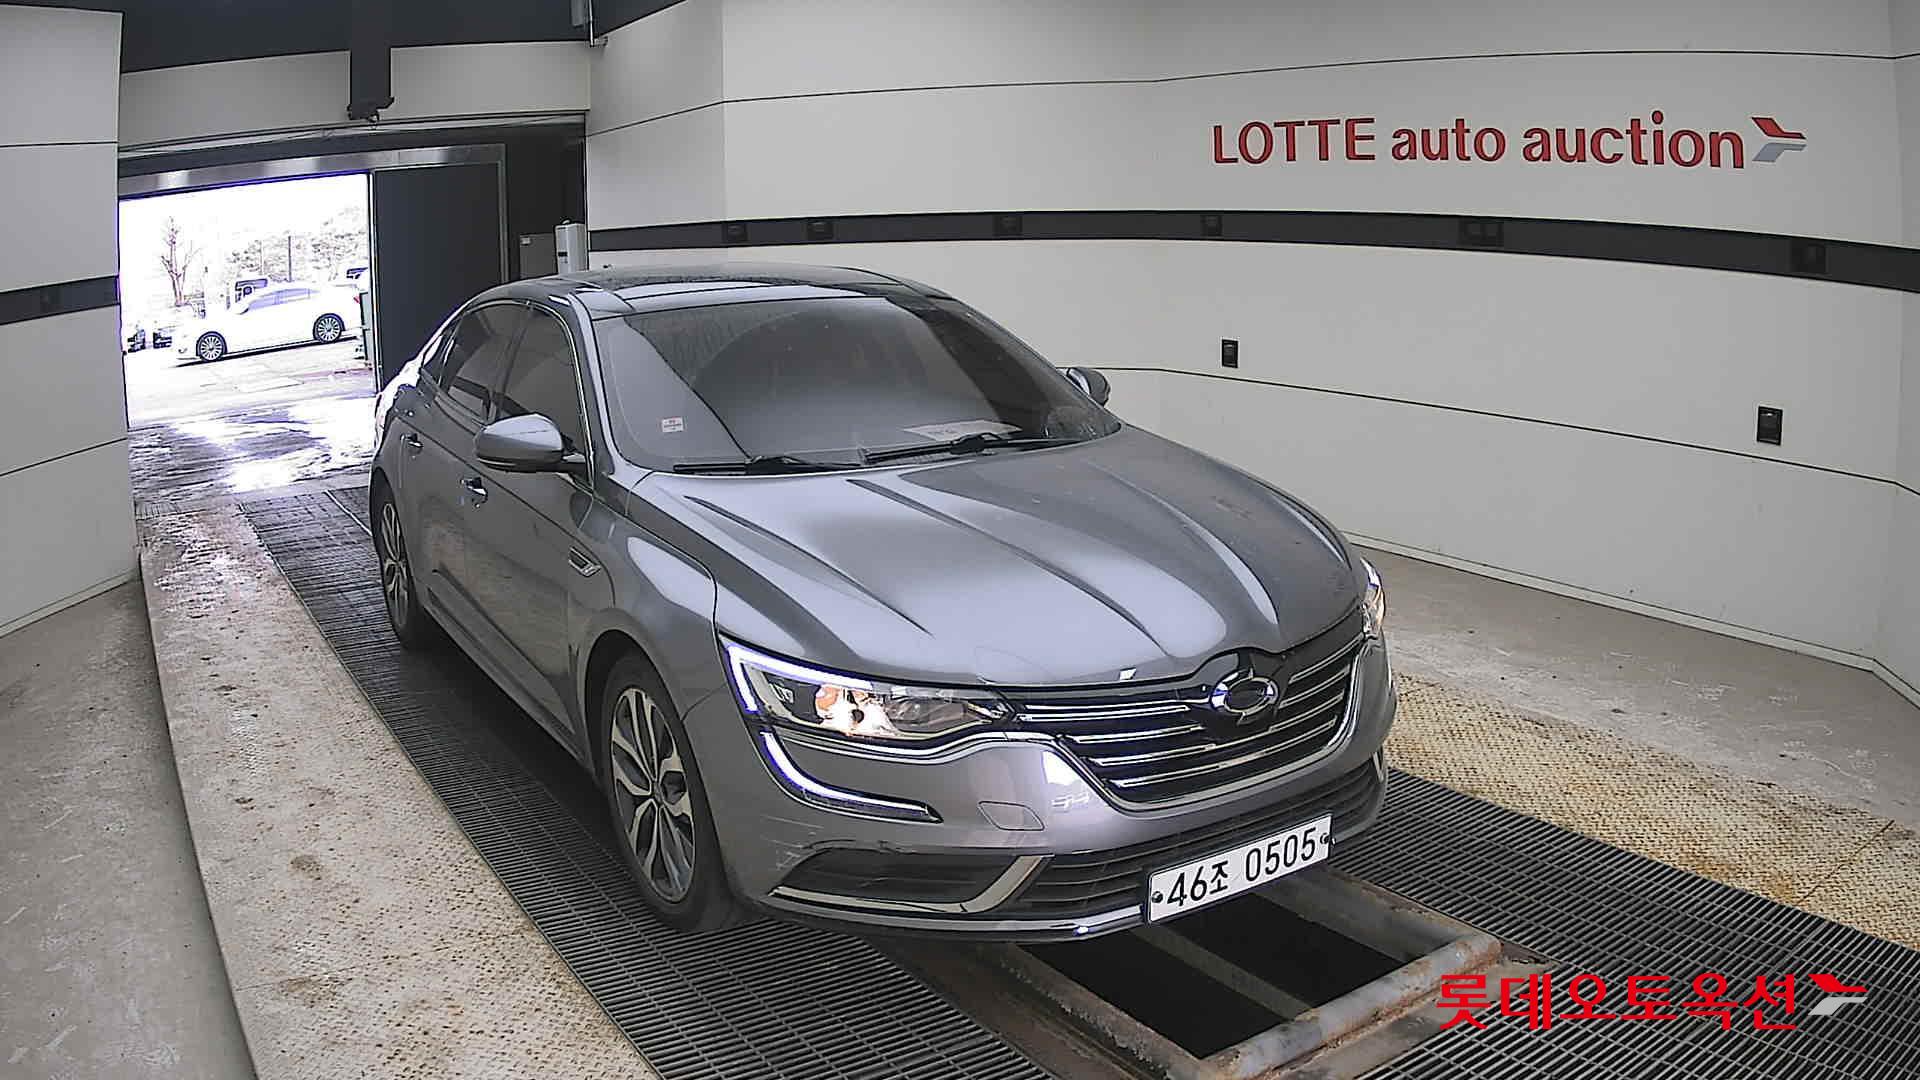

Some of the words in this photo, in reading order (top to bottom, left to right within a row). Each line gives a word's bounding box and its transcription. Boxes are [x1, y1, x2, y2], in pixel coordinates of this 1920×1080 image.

[1212, 117, 1376, 164] LOTTE
[1391, 118, 1506, 162] auto
[1522, 111, 1745, 169] auction
[1167, 860, 1228, 906] 46조
[1245, 827, 1317, 881] 0505
